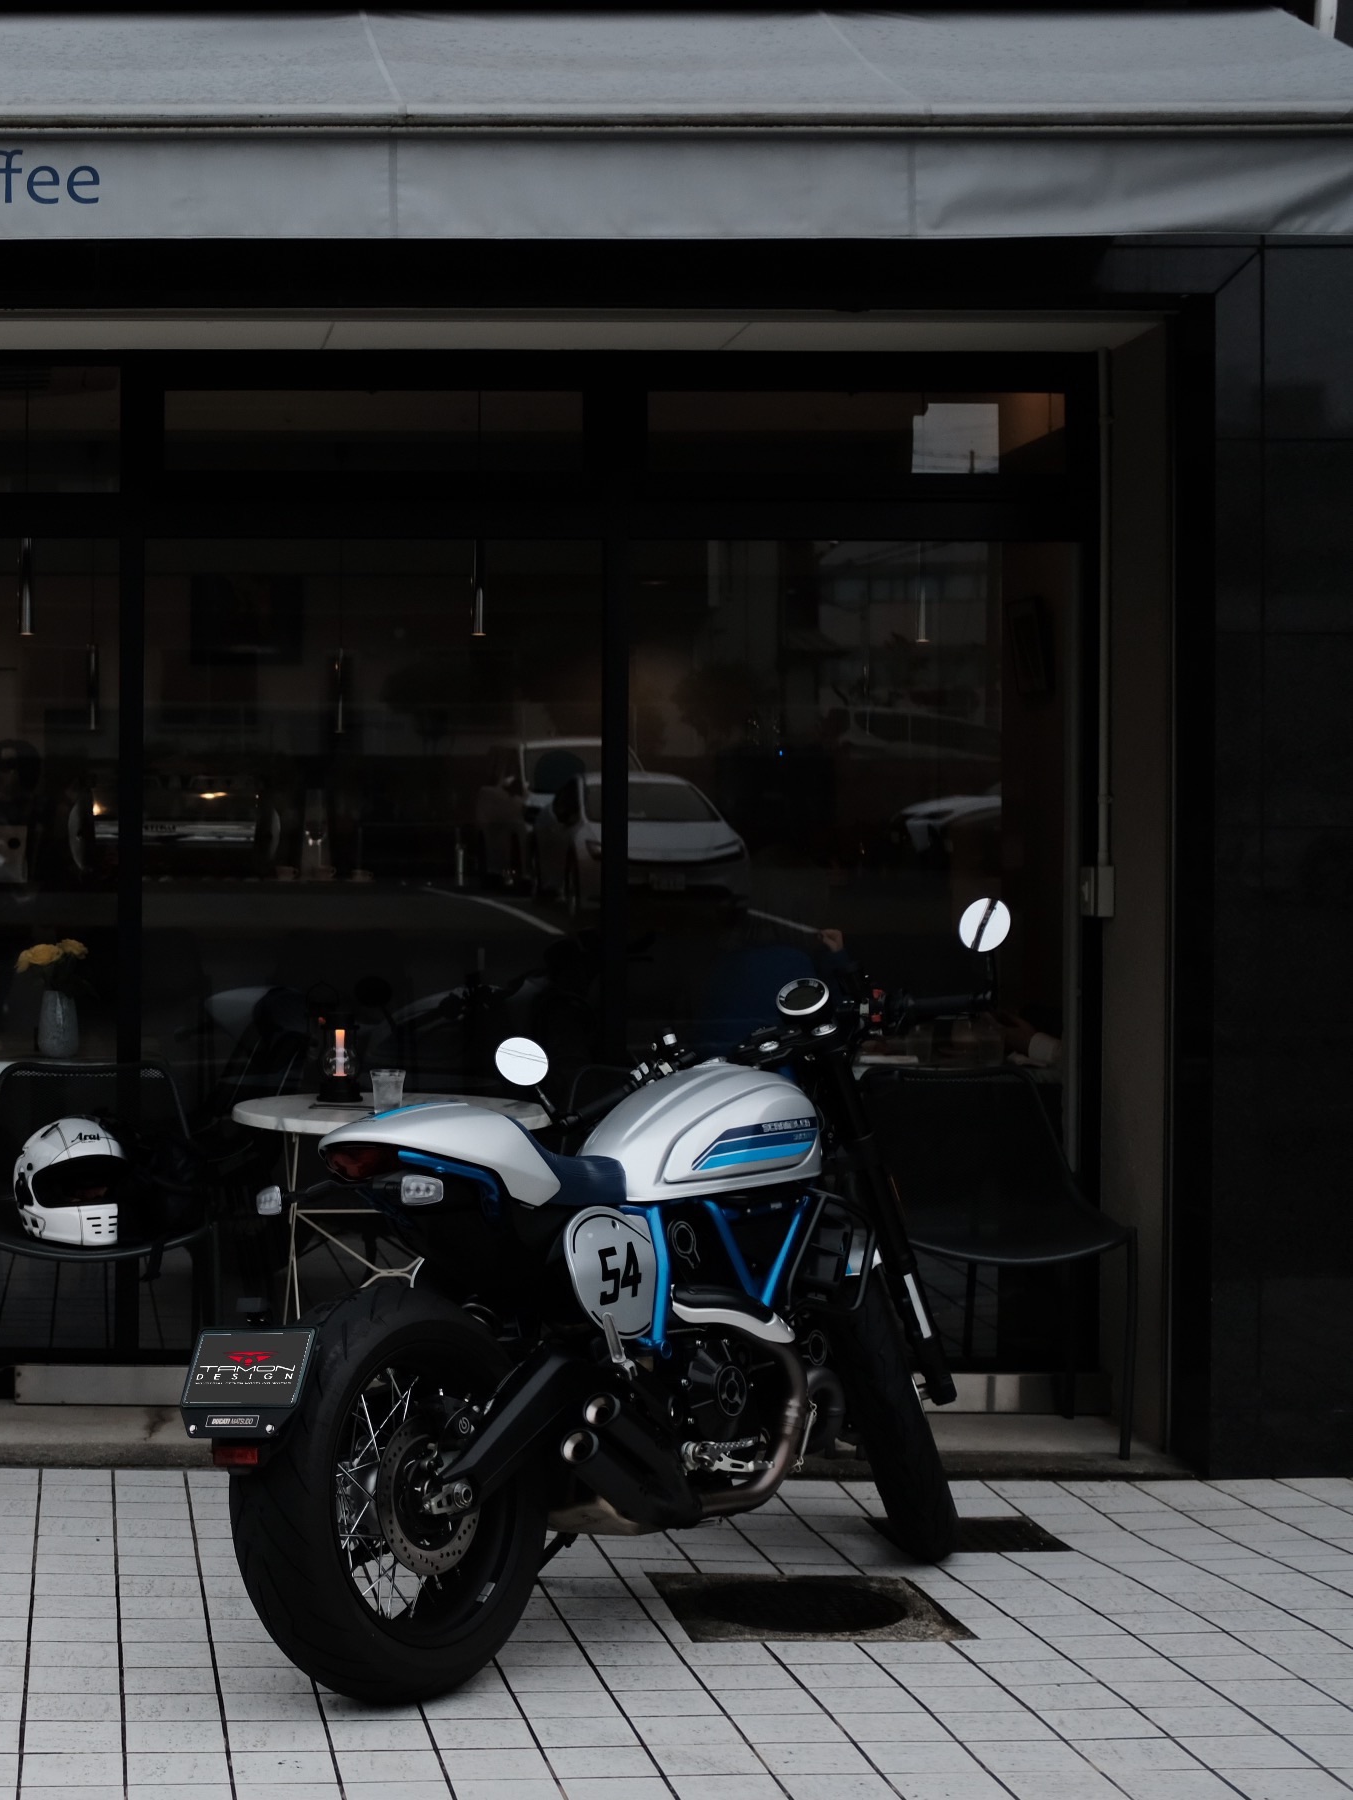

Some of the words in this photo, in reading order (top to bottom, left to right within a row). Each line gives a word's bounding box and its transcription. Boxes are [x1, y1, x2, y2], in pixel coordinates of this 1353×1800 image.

[71, 1132, 101, 1143] Arai
[598, 1241, 642, 1306] 54
[199, 1364, 296, 1373] TAMON
